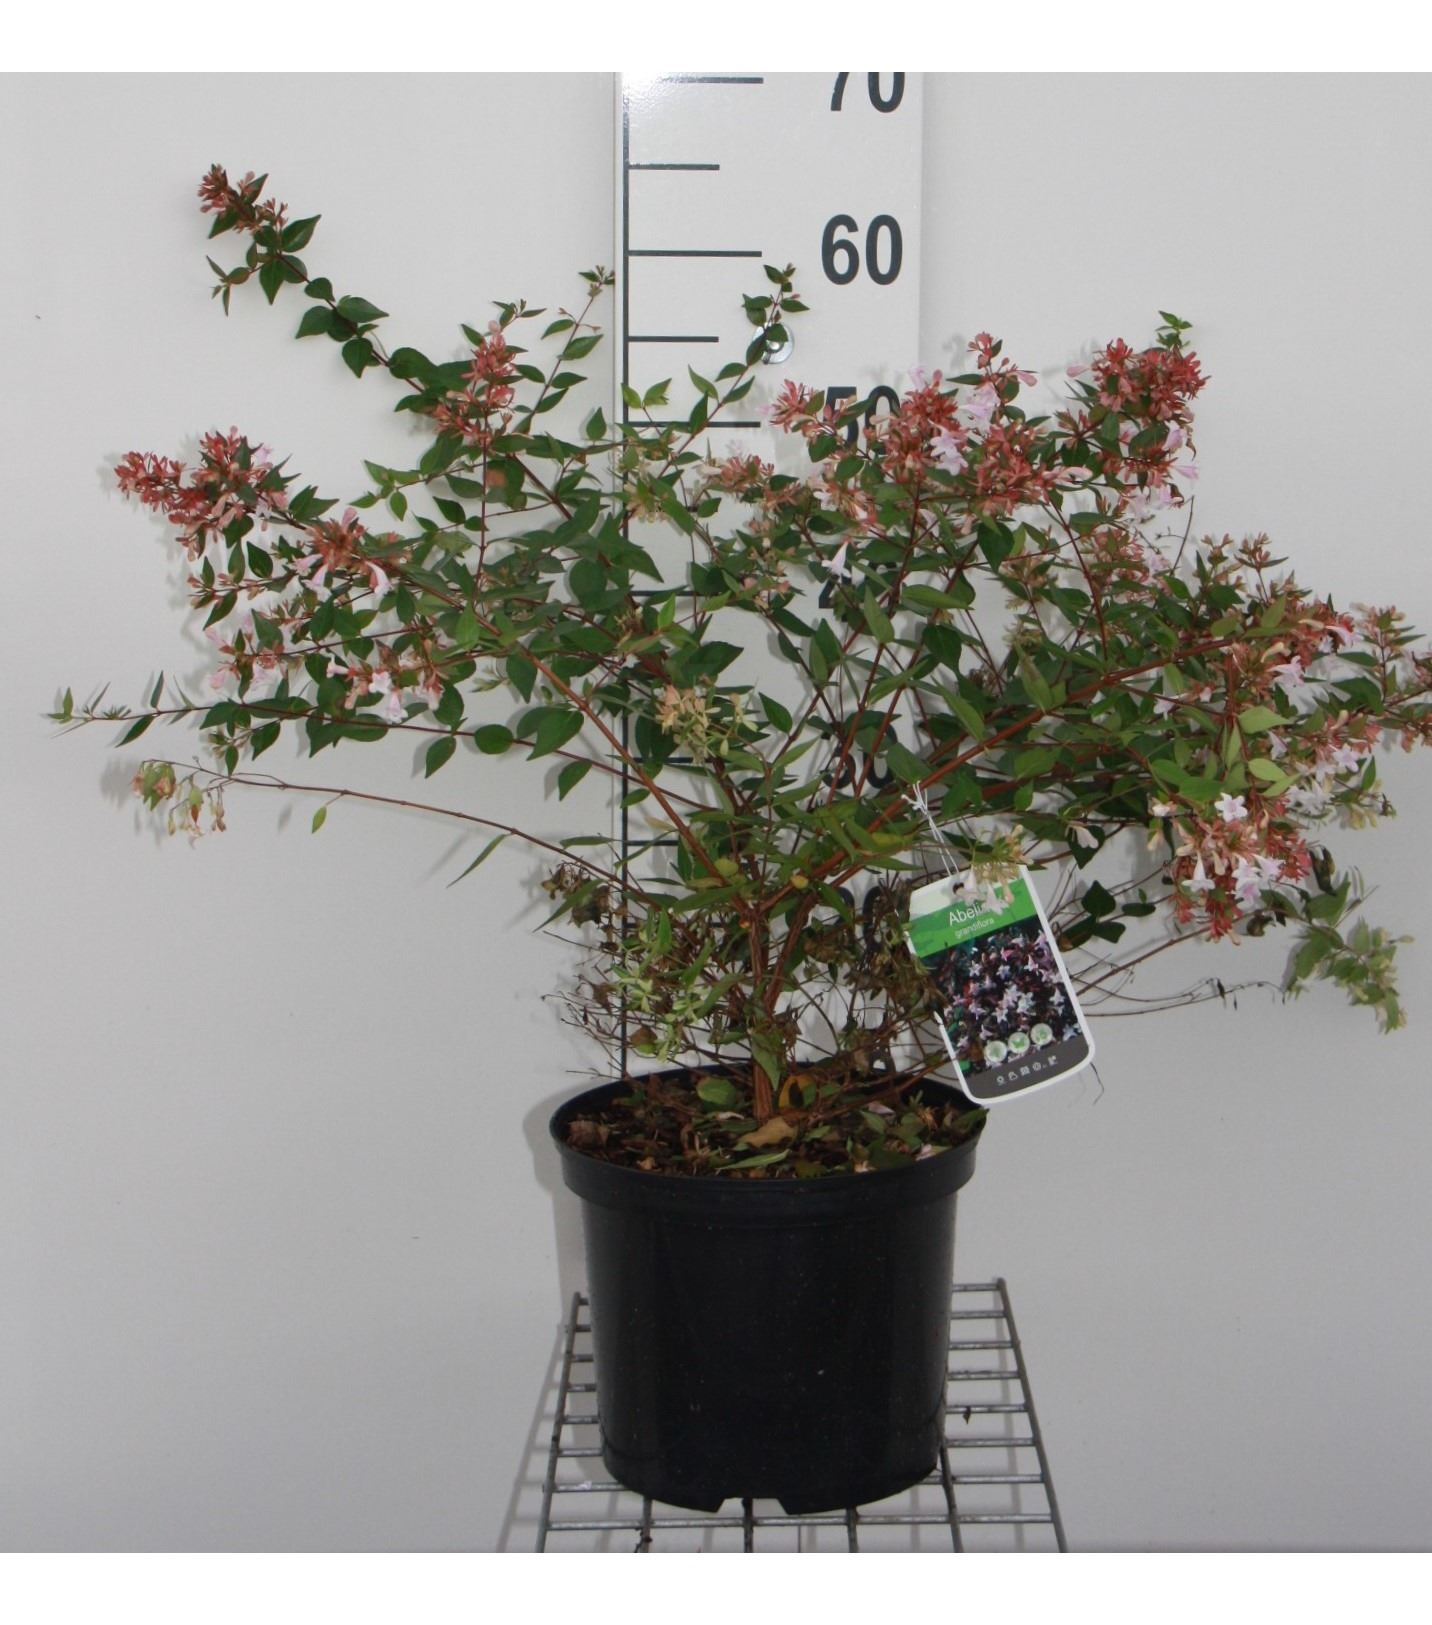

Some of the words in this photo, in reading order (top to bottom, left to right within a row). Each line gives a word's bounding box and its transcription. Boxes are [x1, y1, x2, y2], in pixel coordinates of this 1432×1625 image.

[821, 214, 903, 285] 60
[949, 901, 988, 927] Abeli
[954, 918, 995, 939] grandiflora
